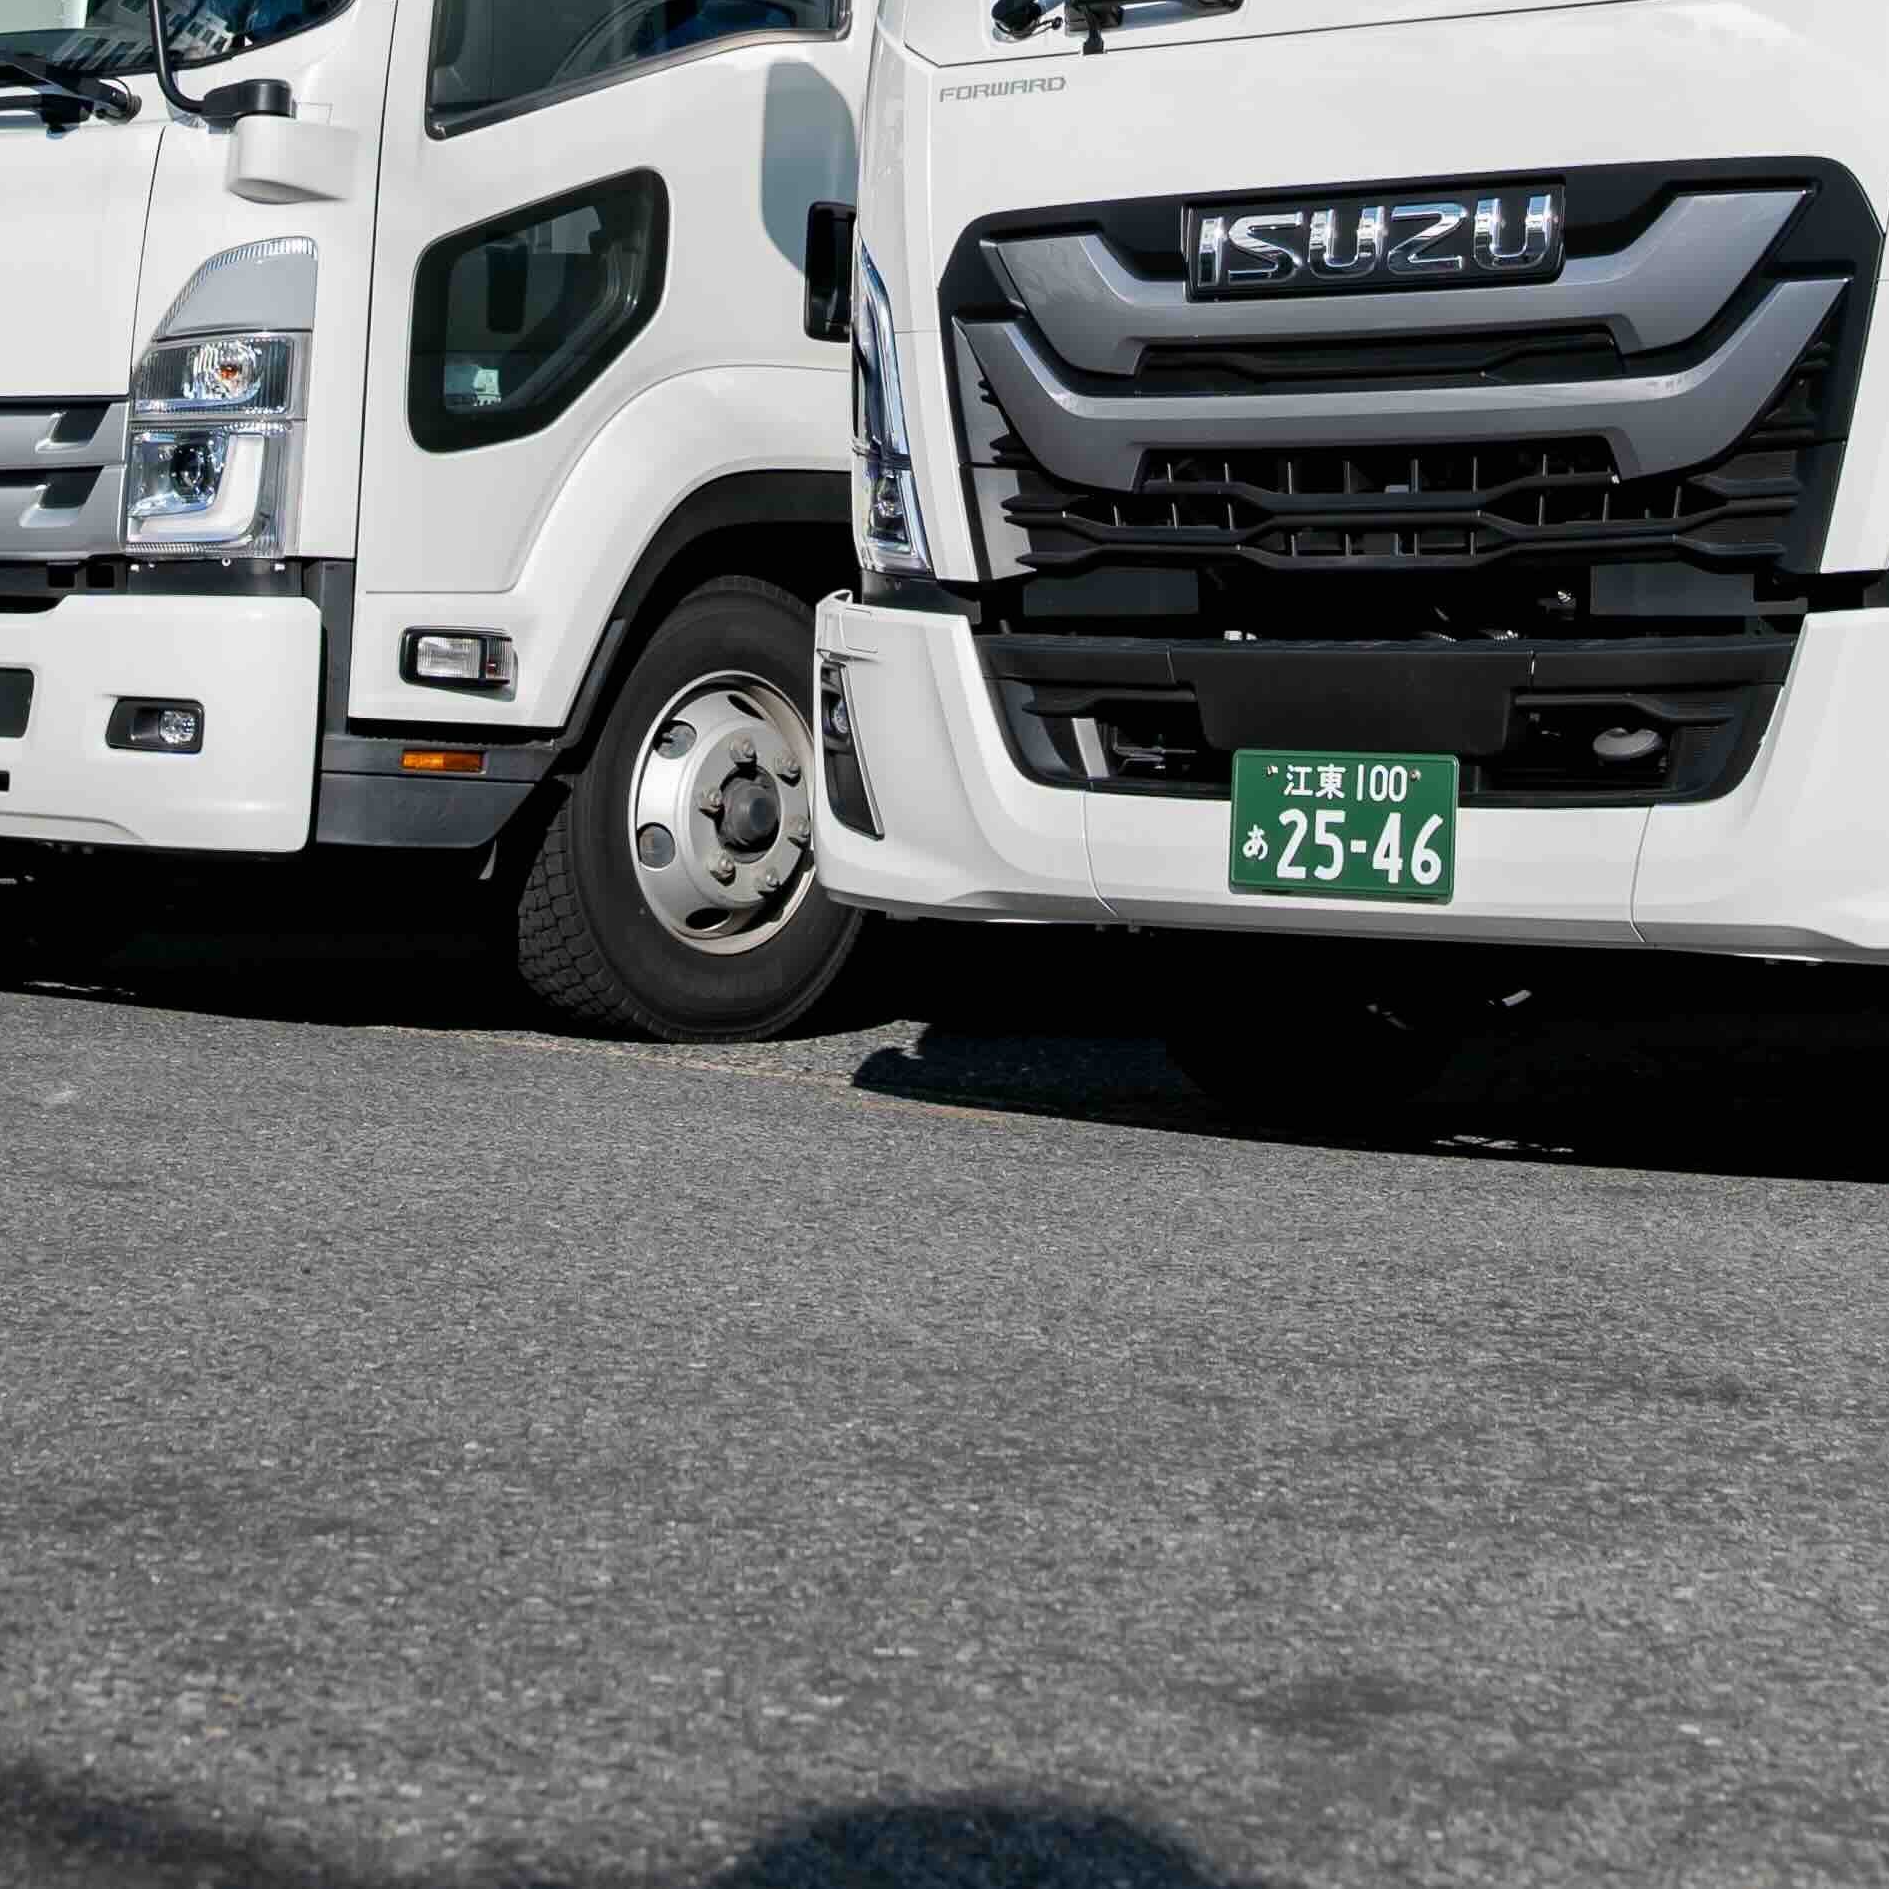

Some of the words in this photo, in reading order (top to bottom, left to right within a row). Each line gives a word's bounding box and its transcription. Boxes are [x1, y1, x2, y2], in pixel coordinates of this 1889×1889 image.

[939, 76, 1067, 103] FORWARD
[1198, 195, 1554, 287] ISUZU
[1283, 763, 1346, 800] 江東
[1356, 764, 1408, 802] 100
[1242, 823, 1269, 860] あ
[1276, 808, 1444, 885] 25-46
